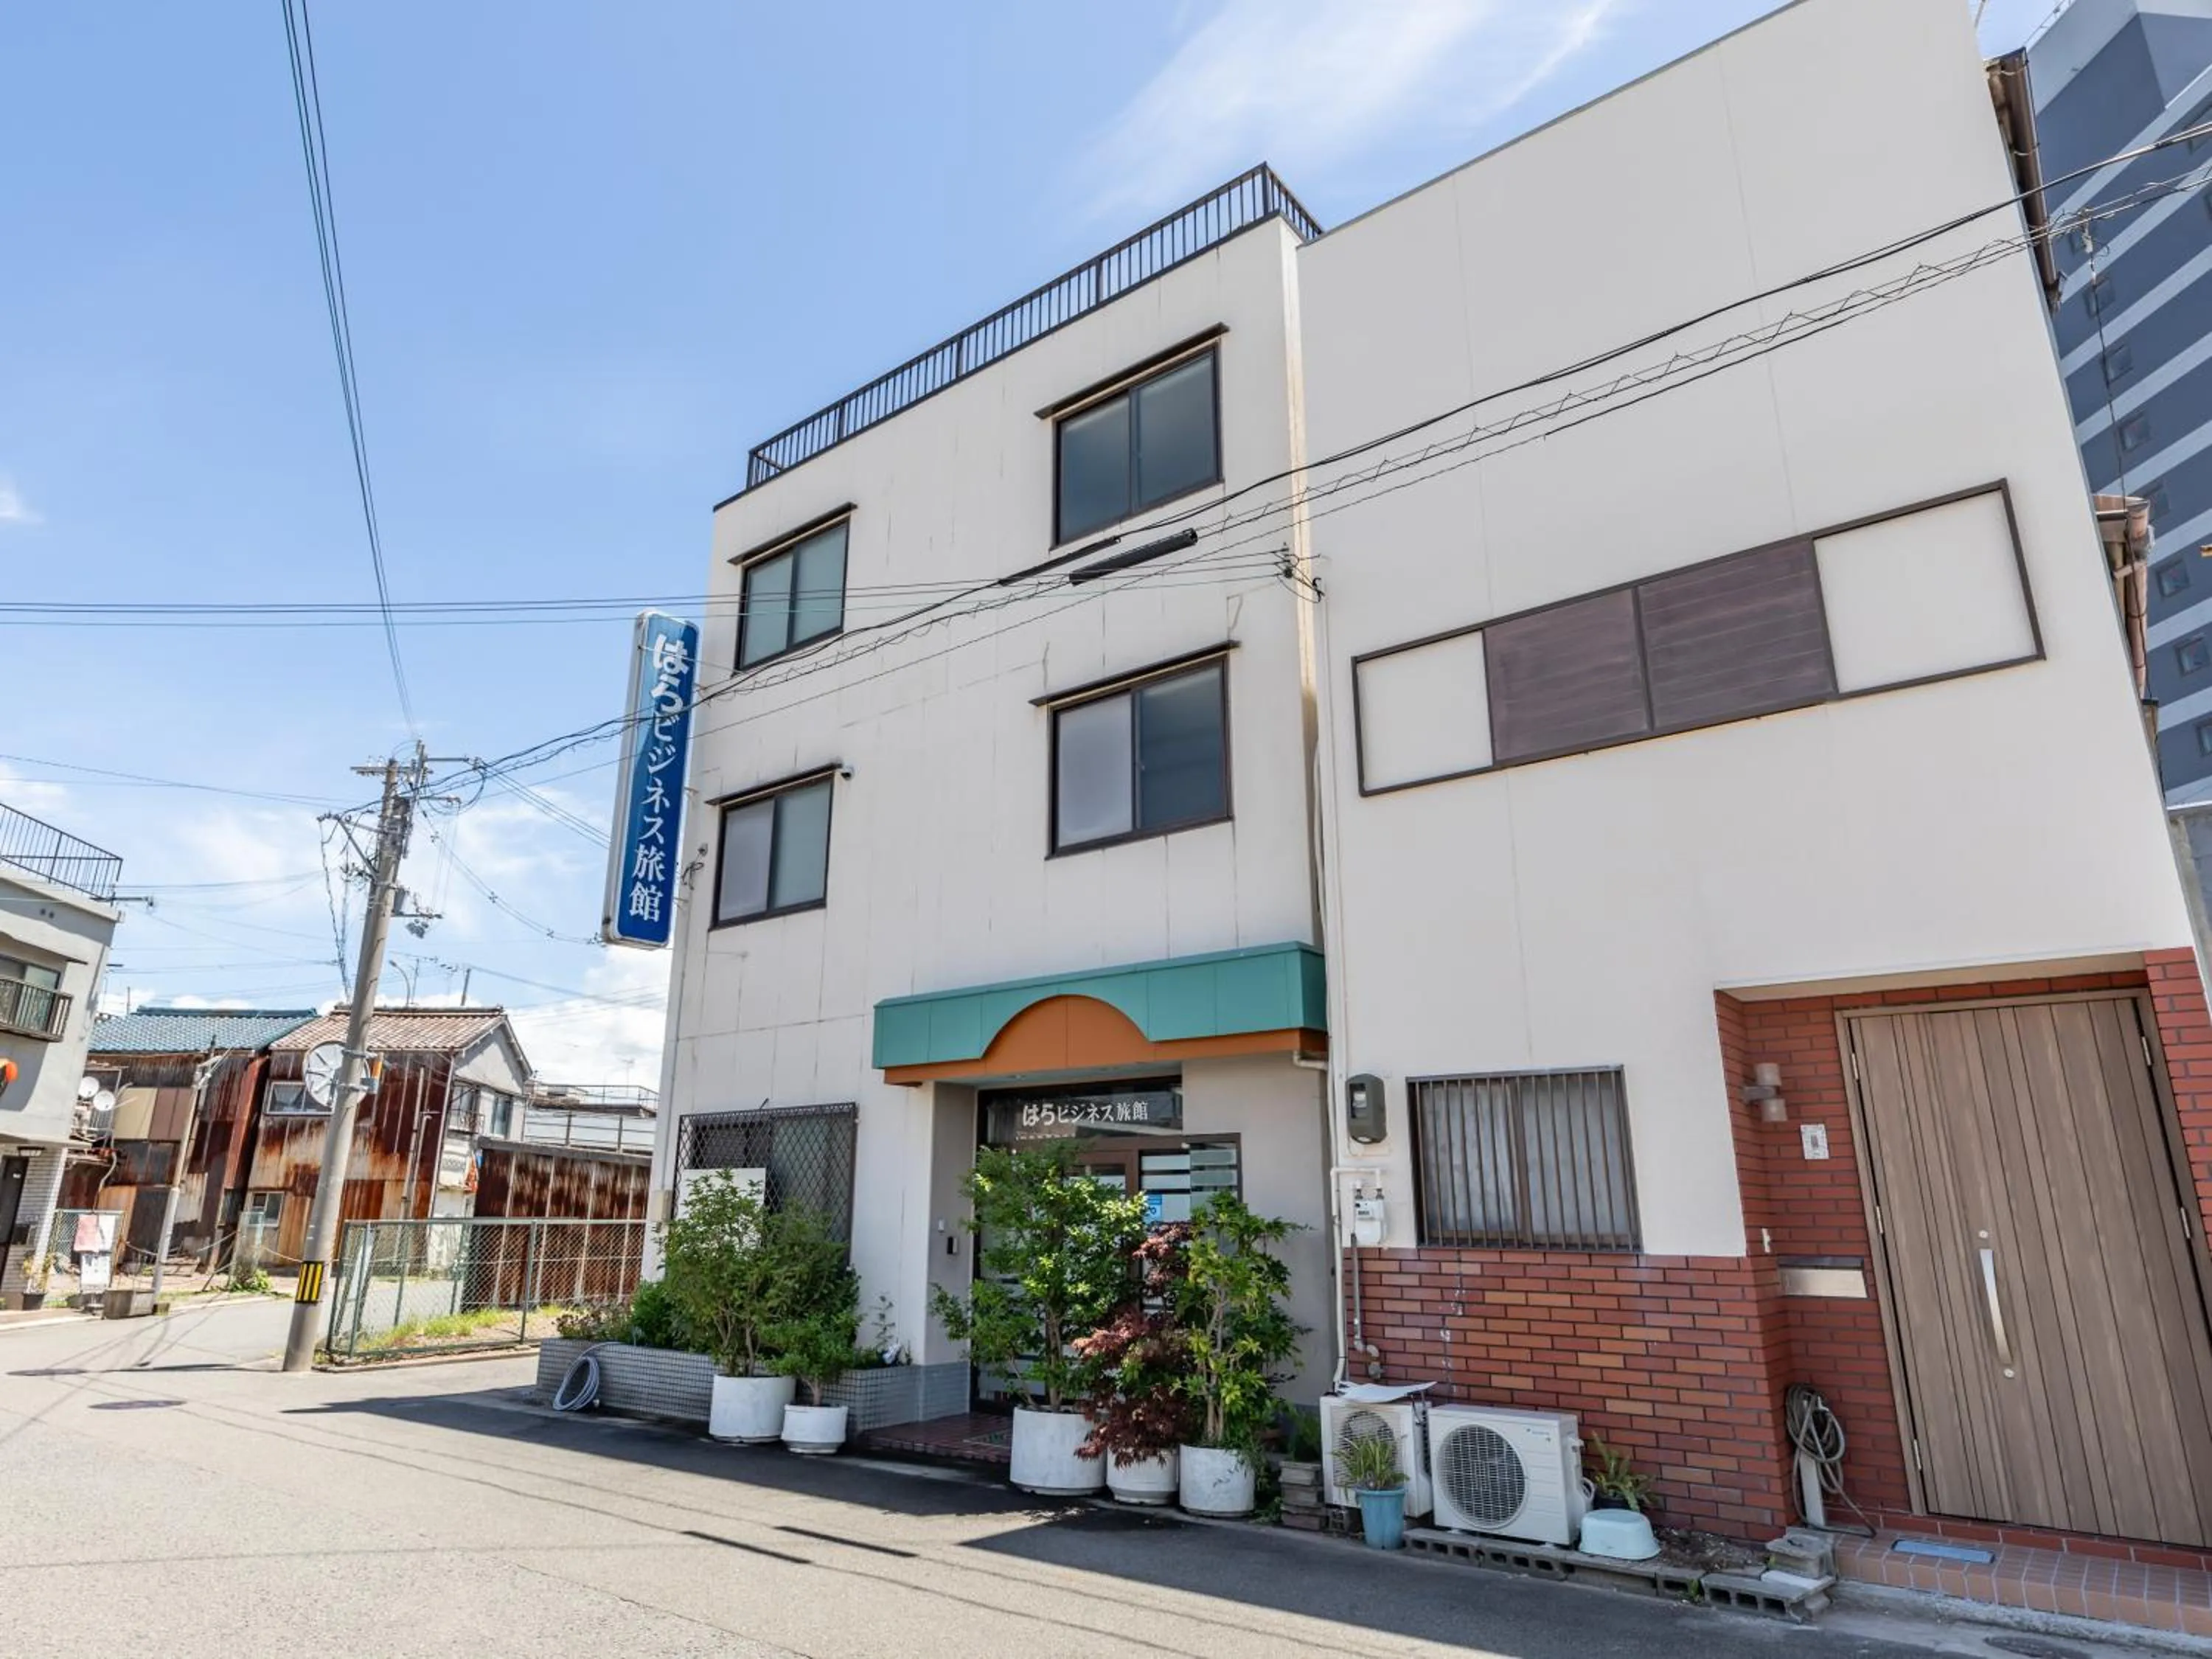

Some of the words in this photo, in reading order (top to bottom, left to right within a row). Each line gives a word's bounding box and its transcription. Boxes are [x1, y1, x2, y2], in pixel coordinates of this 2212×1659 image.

[629, 633, 689, 922] はらビジネス旅館
[1023, 1101, 1148, 1127] はらビジネス旅館
